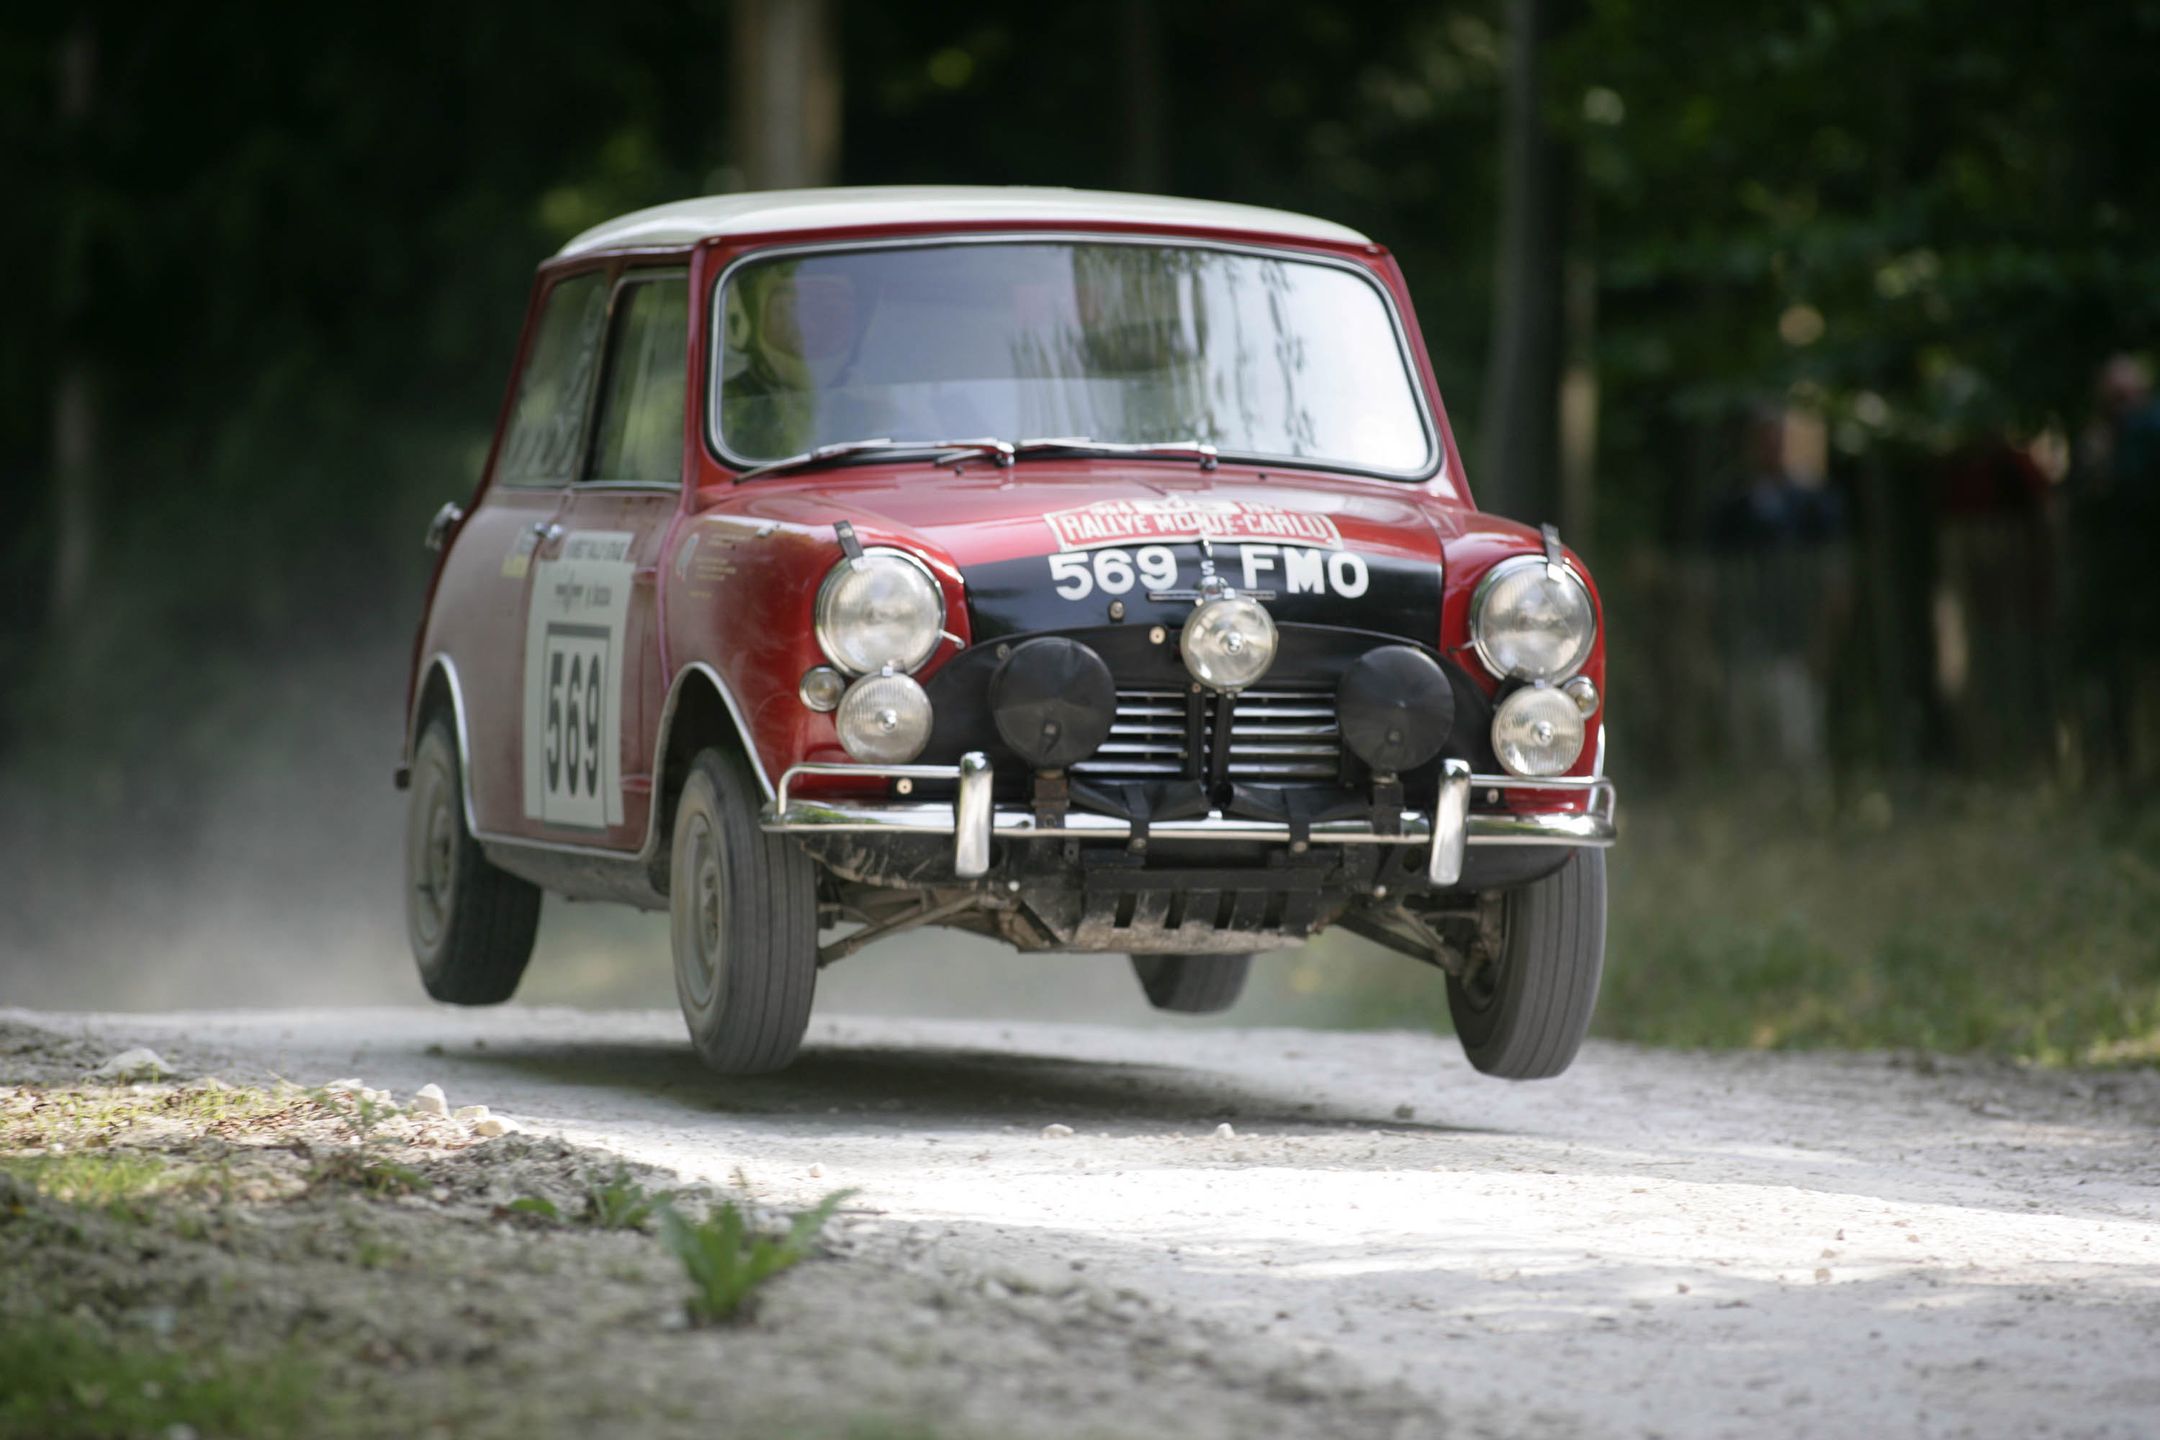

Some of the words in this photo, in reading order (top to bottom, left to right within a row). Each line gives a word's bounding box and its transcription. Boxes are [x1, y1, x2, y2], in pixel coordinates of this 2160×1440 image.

[1048, 545, 1178, 600] 569
[1239, 544, 1369, 599] FMO
[548, 652, 600, 798] 569
